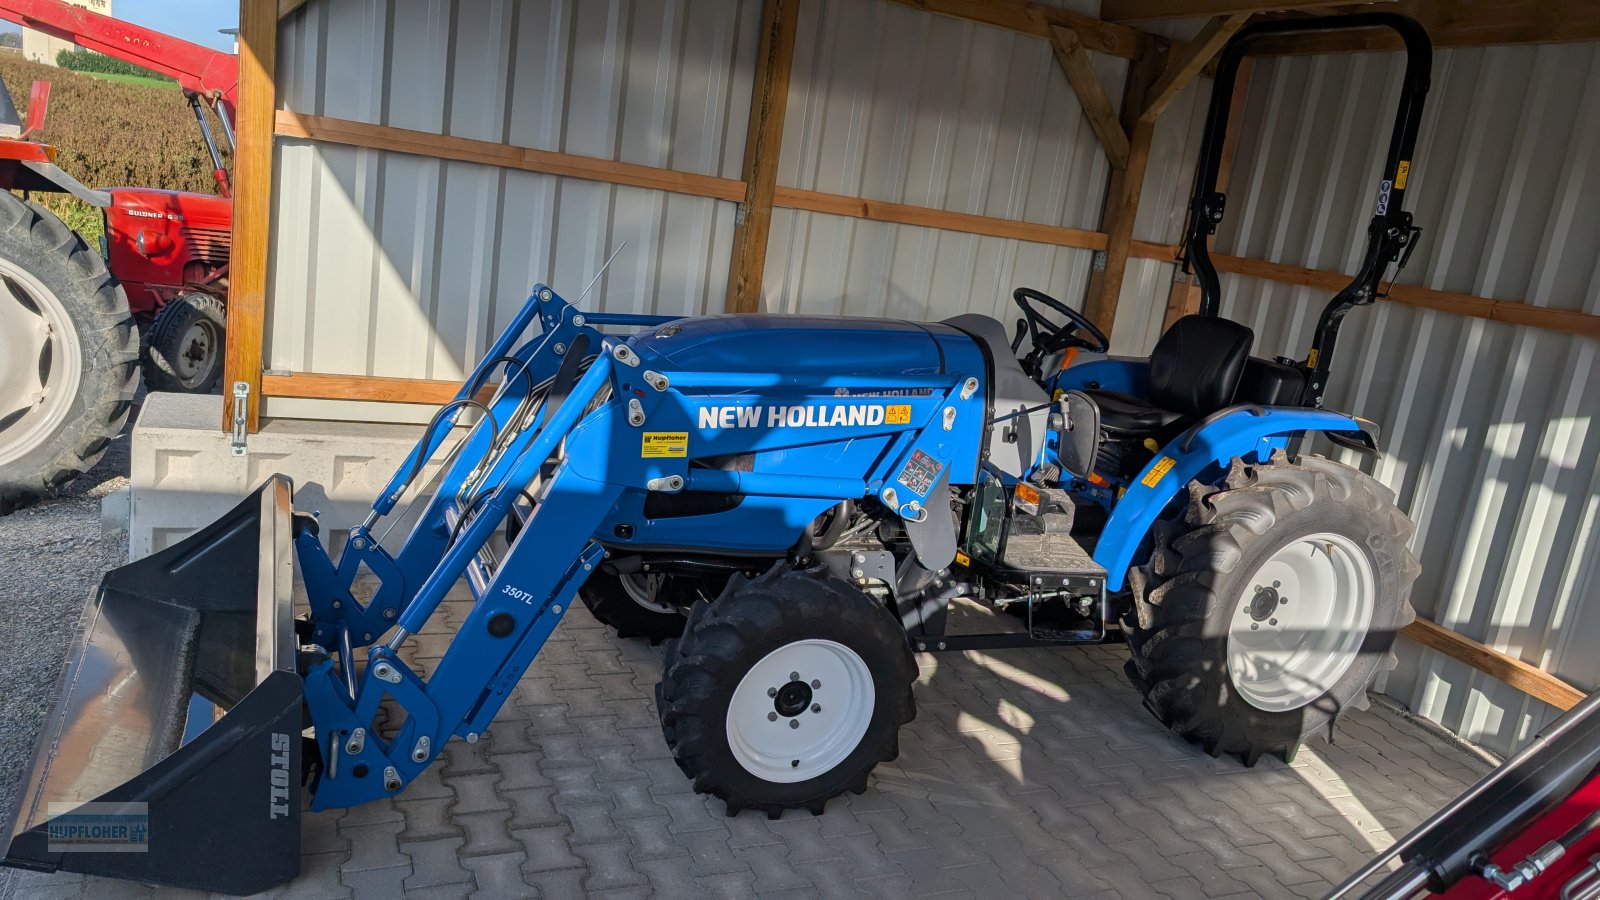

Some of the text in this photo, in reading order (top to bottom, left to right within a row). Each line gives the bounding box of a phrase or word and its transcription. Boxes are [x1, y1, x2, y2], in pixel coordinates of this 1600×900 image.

[698, 405, 884, 429] NEW HOLLAND
[502, 584, 533, 605] 350TL
[270, 732, 290, 820] STOLL
